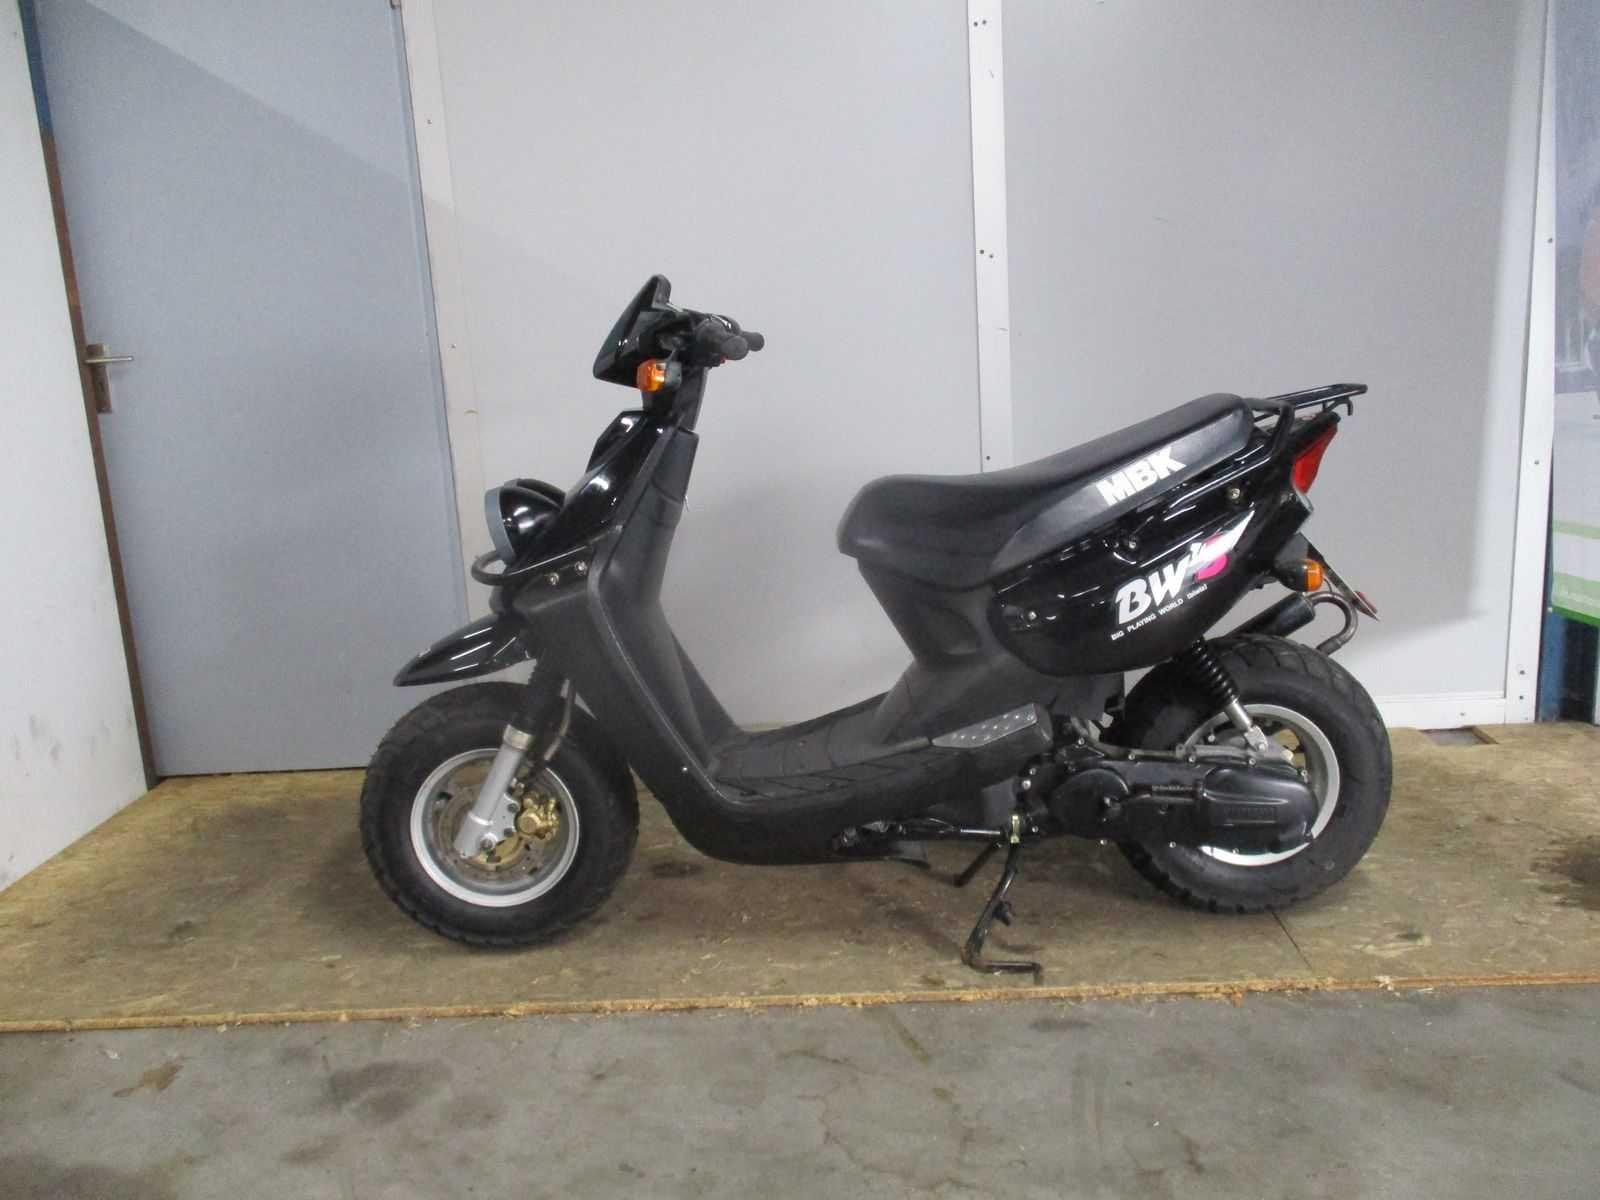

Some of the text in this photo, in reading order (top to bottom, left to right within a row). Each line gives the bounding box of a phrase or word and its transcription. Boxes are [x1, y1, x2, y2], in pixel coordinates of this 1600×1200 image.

[1096, 446, 1187, 507] MBK
[1110, 598, 1184, 641] BIG PLAYING WORLD
